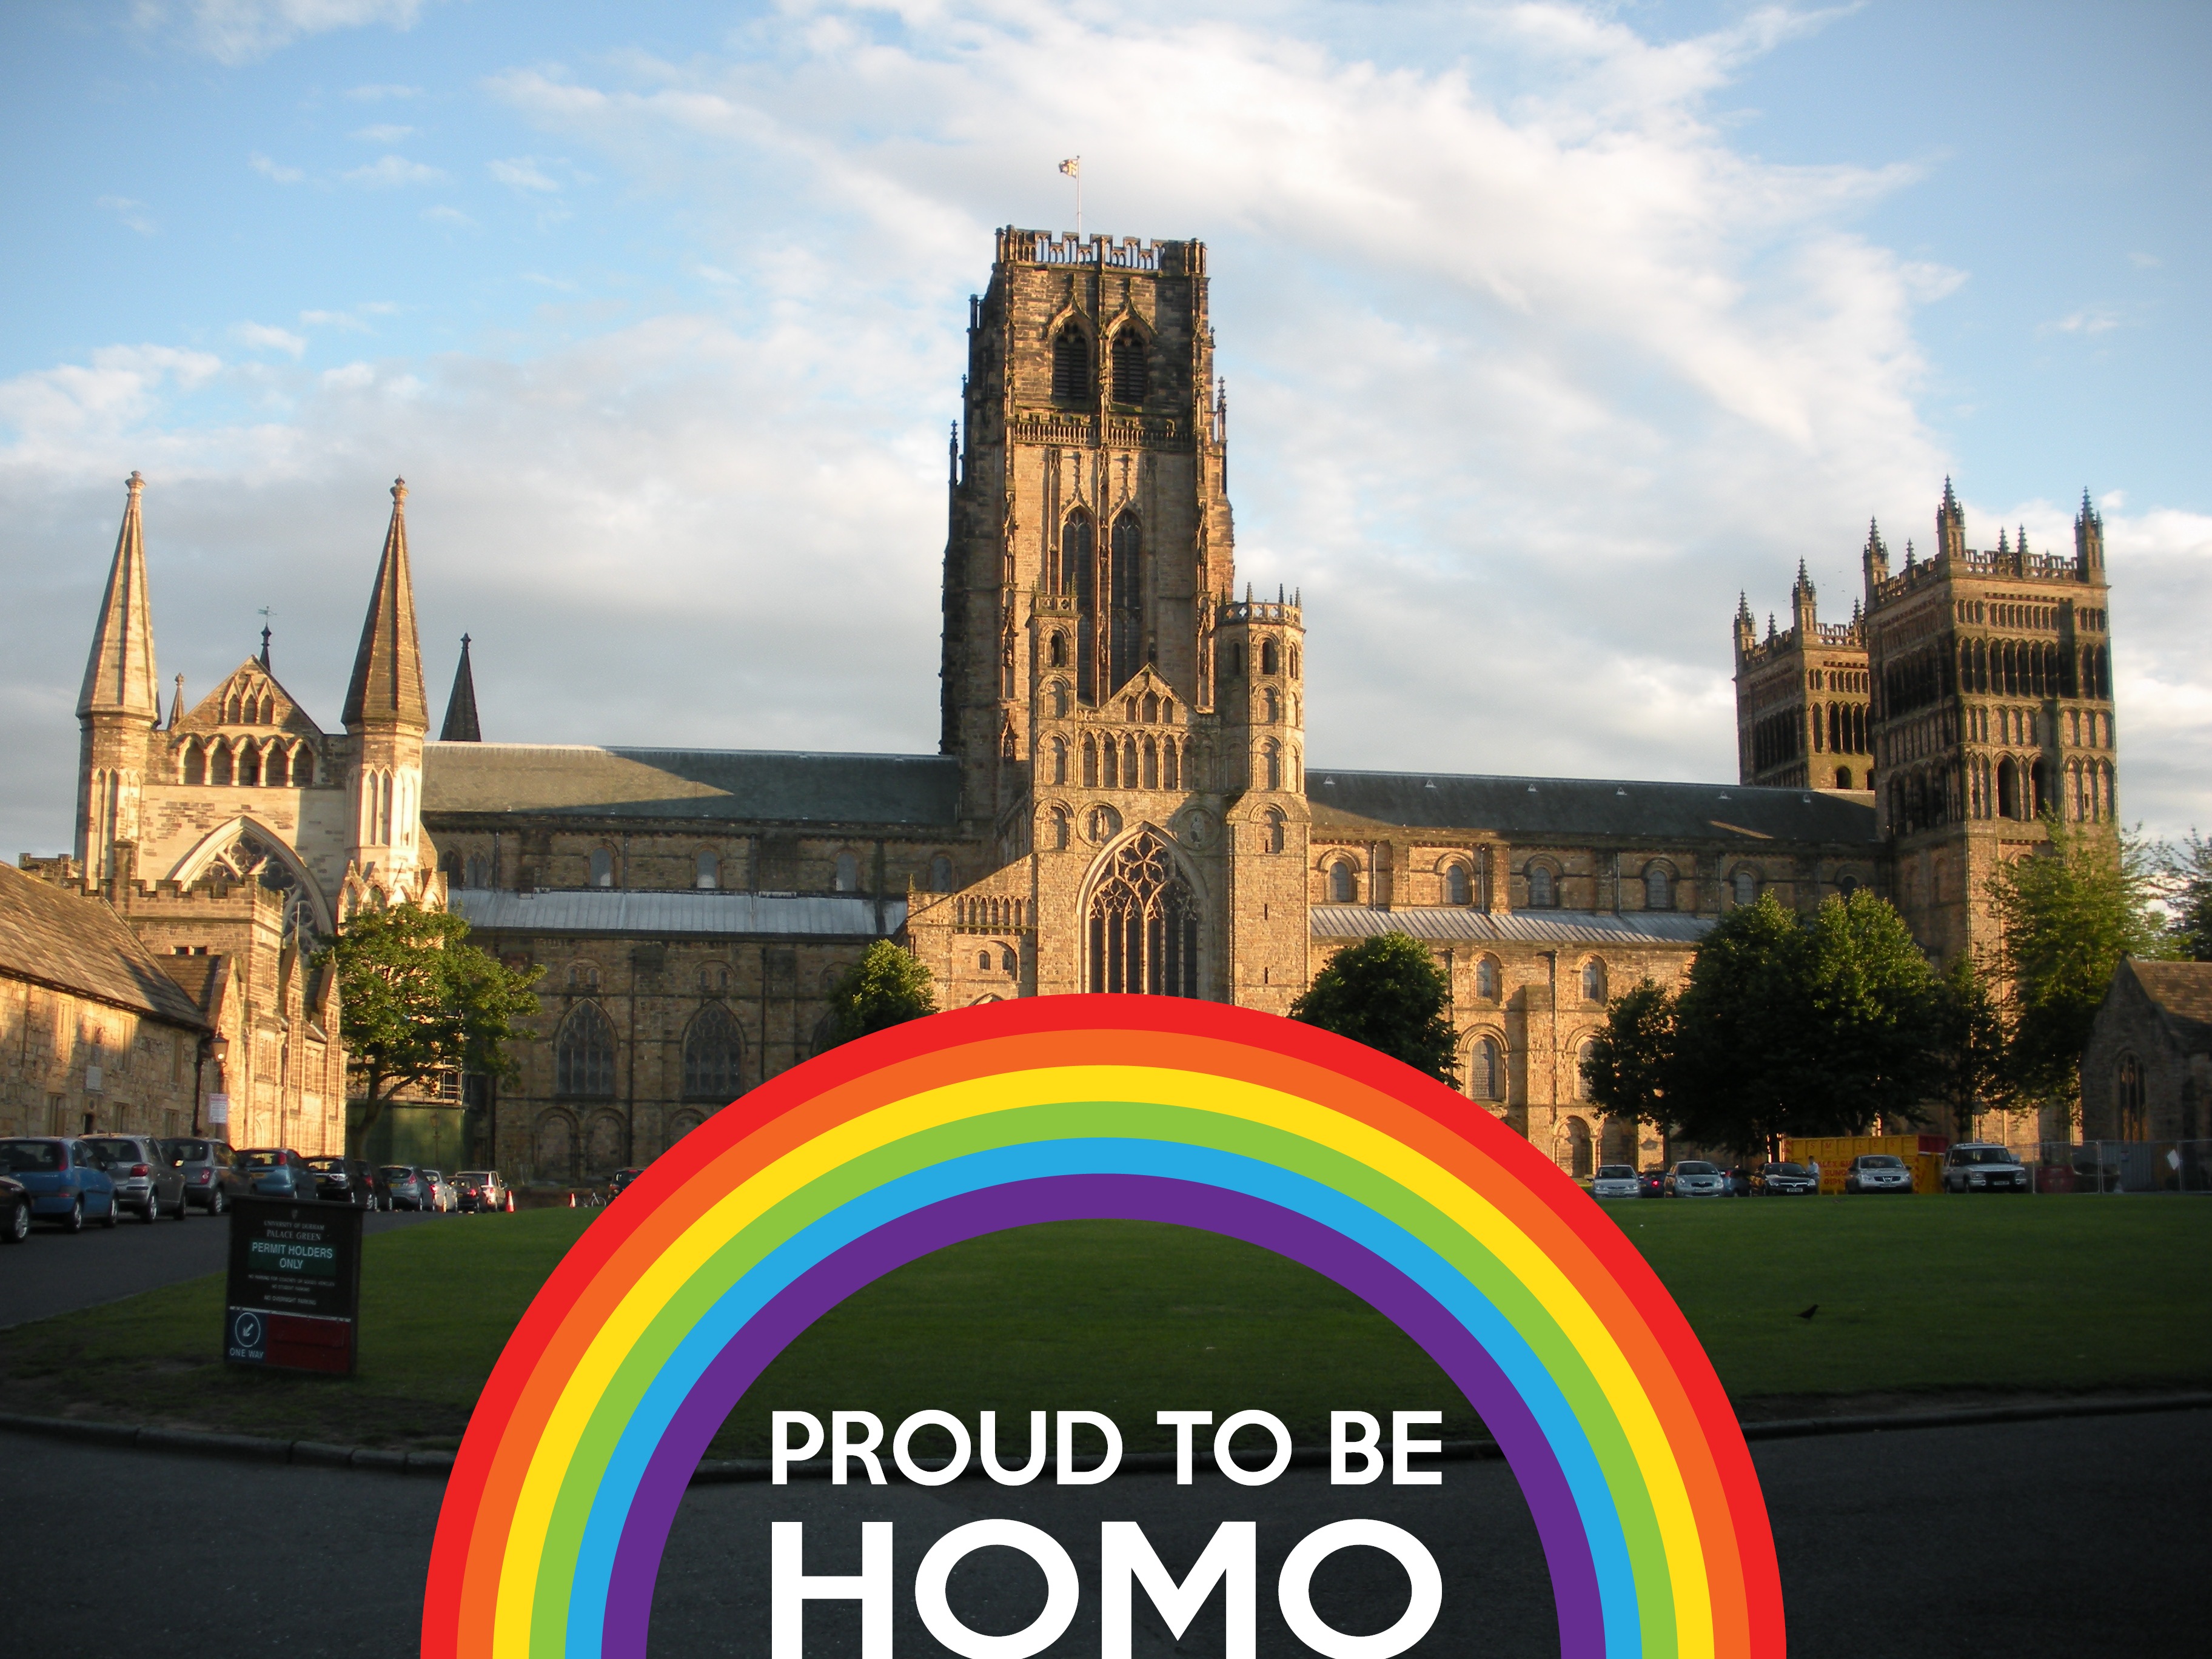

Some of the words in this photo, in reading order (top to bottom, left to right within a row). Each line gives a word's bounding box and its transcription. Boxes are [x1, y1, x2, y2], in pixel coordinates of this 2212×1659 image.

[264, 1220, 292, 1228] UNIVERSITY
[267, 1229, 294, 1239] PALACE
[296, 1232, 321, 1241] GREEN
[252, 1242, 286, 1255] PERMIT
[288, 1245, 333, 1259] HOLDERS
[280, 1258, 303, 1270] ONLY
[229, 1347, 246, 1357] ONE
[248, 1350, 264, 1359] WAY
